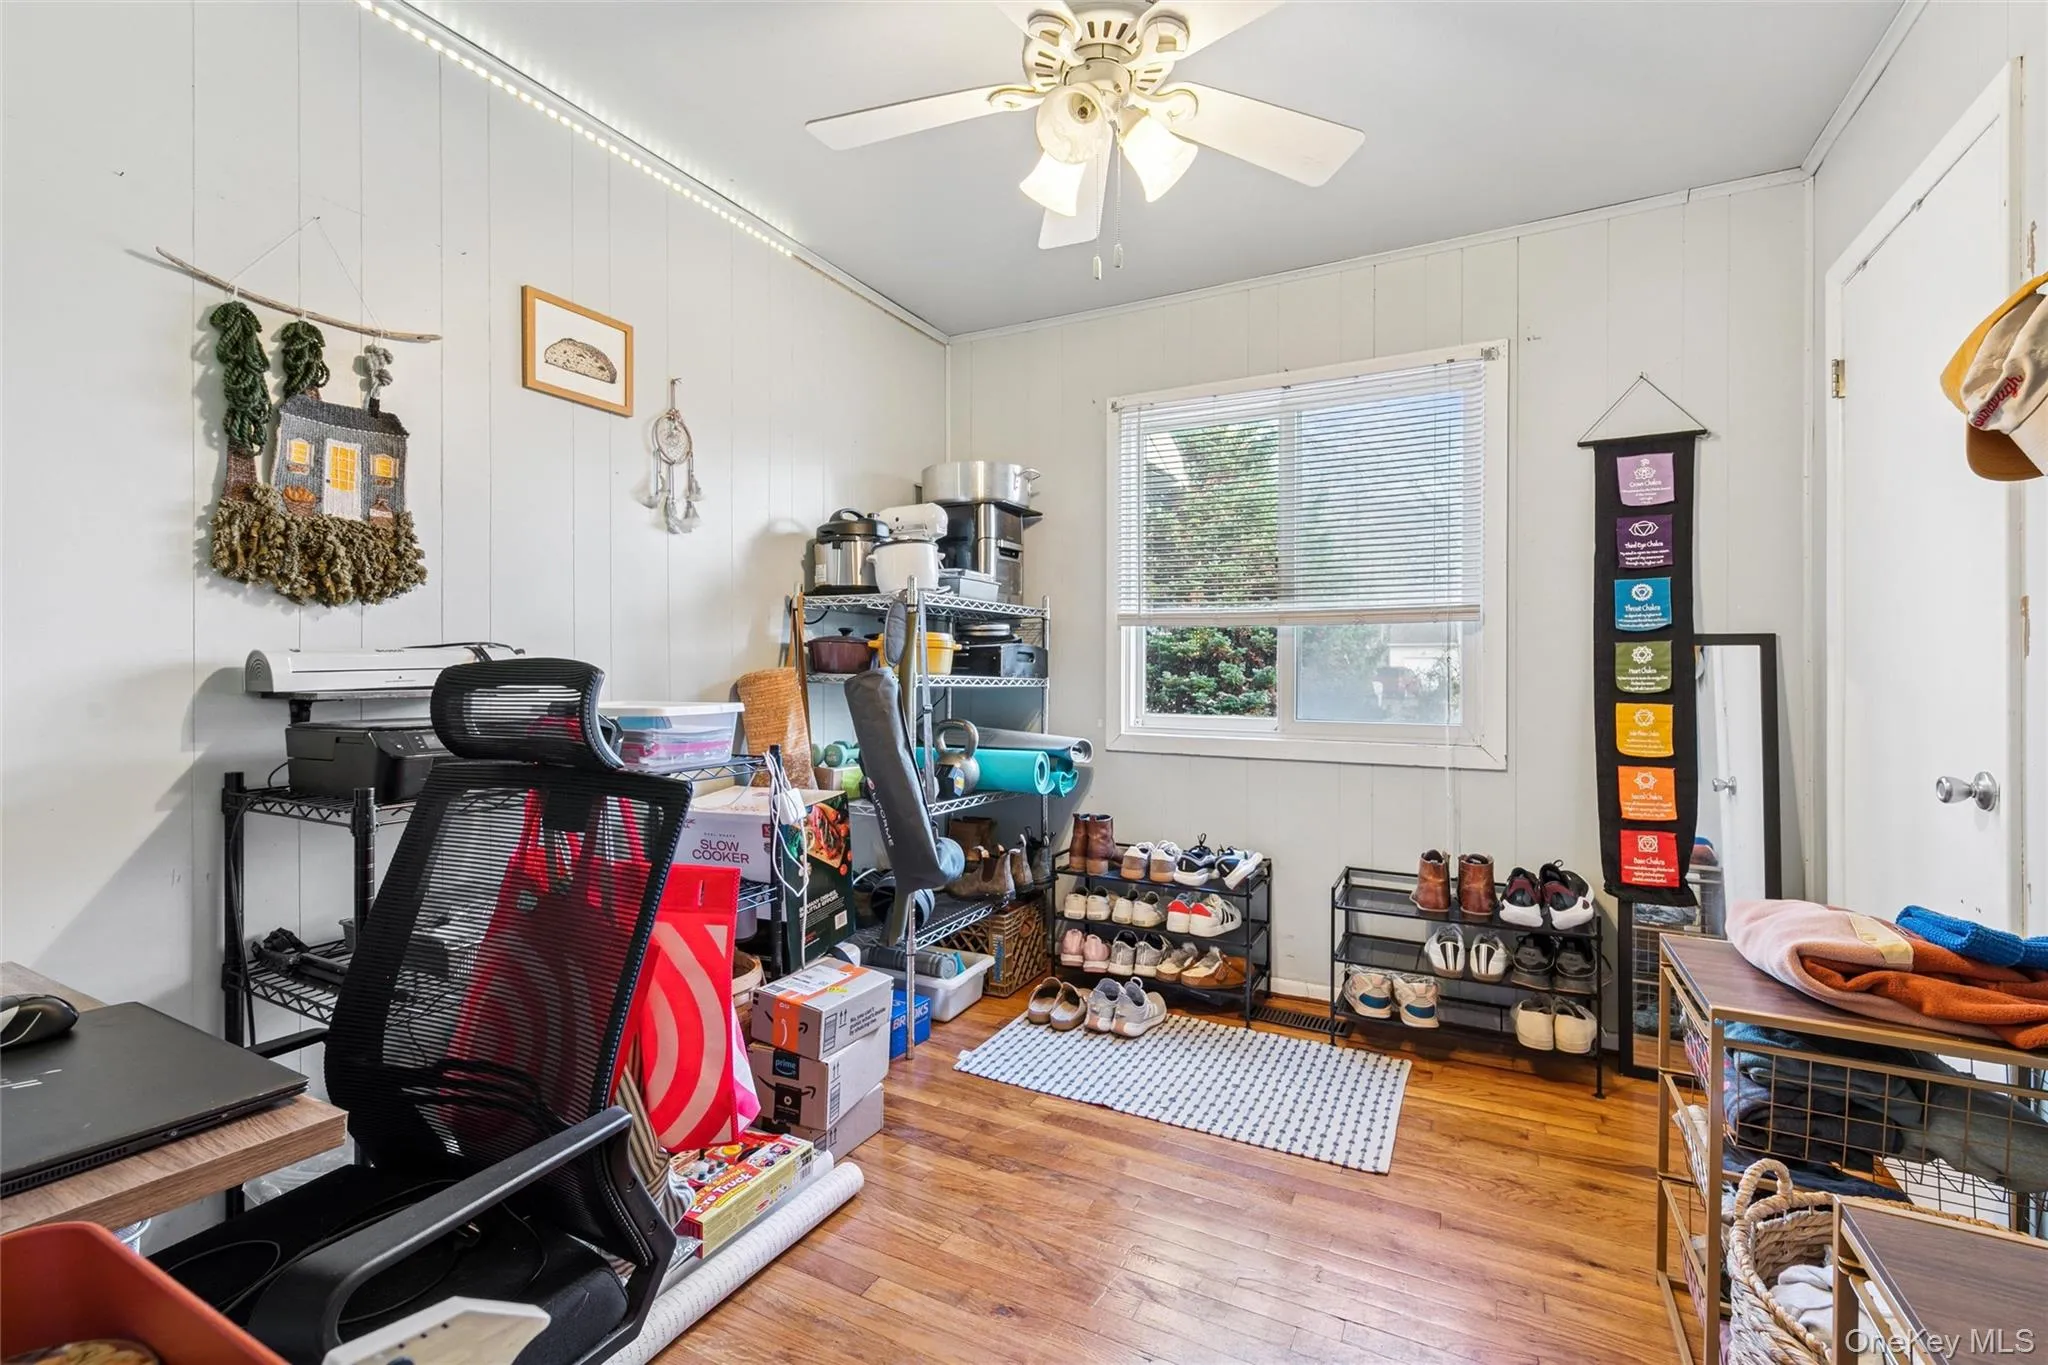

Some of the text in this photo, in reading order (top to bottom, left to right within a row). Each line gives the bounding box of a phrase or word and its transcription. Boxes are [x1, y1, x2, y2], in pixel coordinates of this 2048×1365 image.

[1644, 478, 1662, 487] Chakra
[1624, 539, 1664, 550] Third Eye Chakra
[1641, 603, 1661, 611] Chakra
[700, 839, 740, 852] SLOW
[692, 848, 750, 864] COOKER
[893, 1002, 929, 1032] BROKS
[775, 1058, 797, 1069] prime
[712, 1172, 753, 1195] Truck
